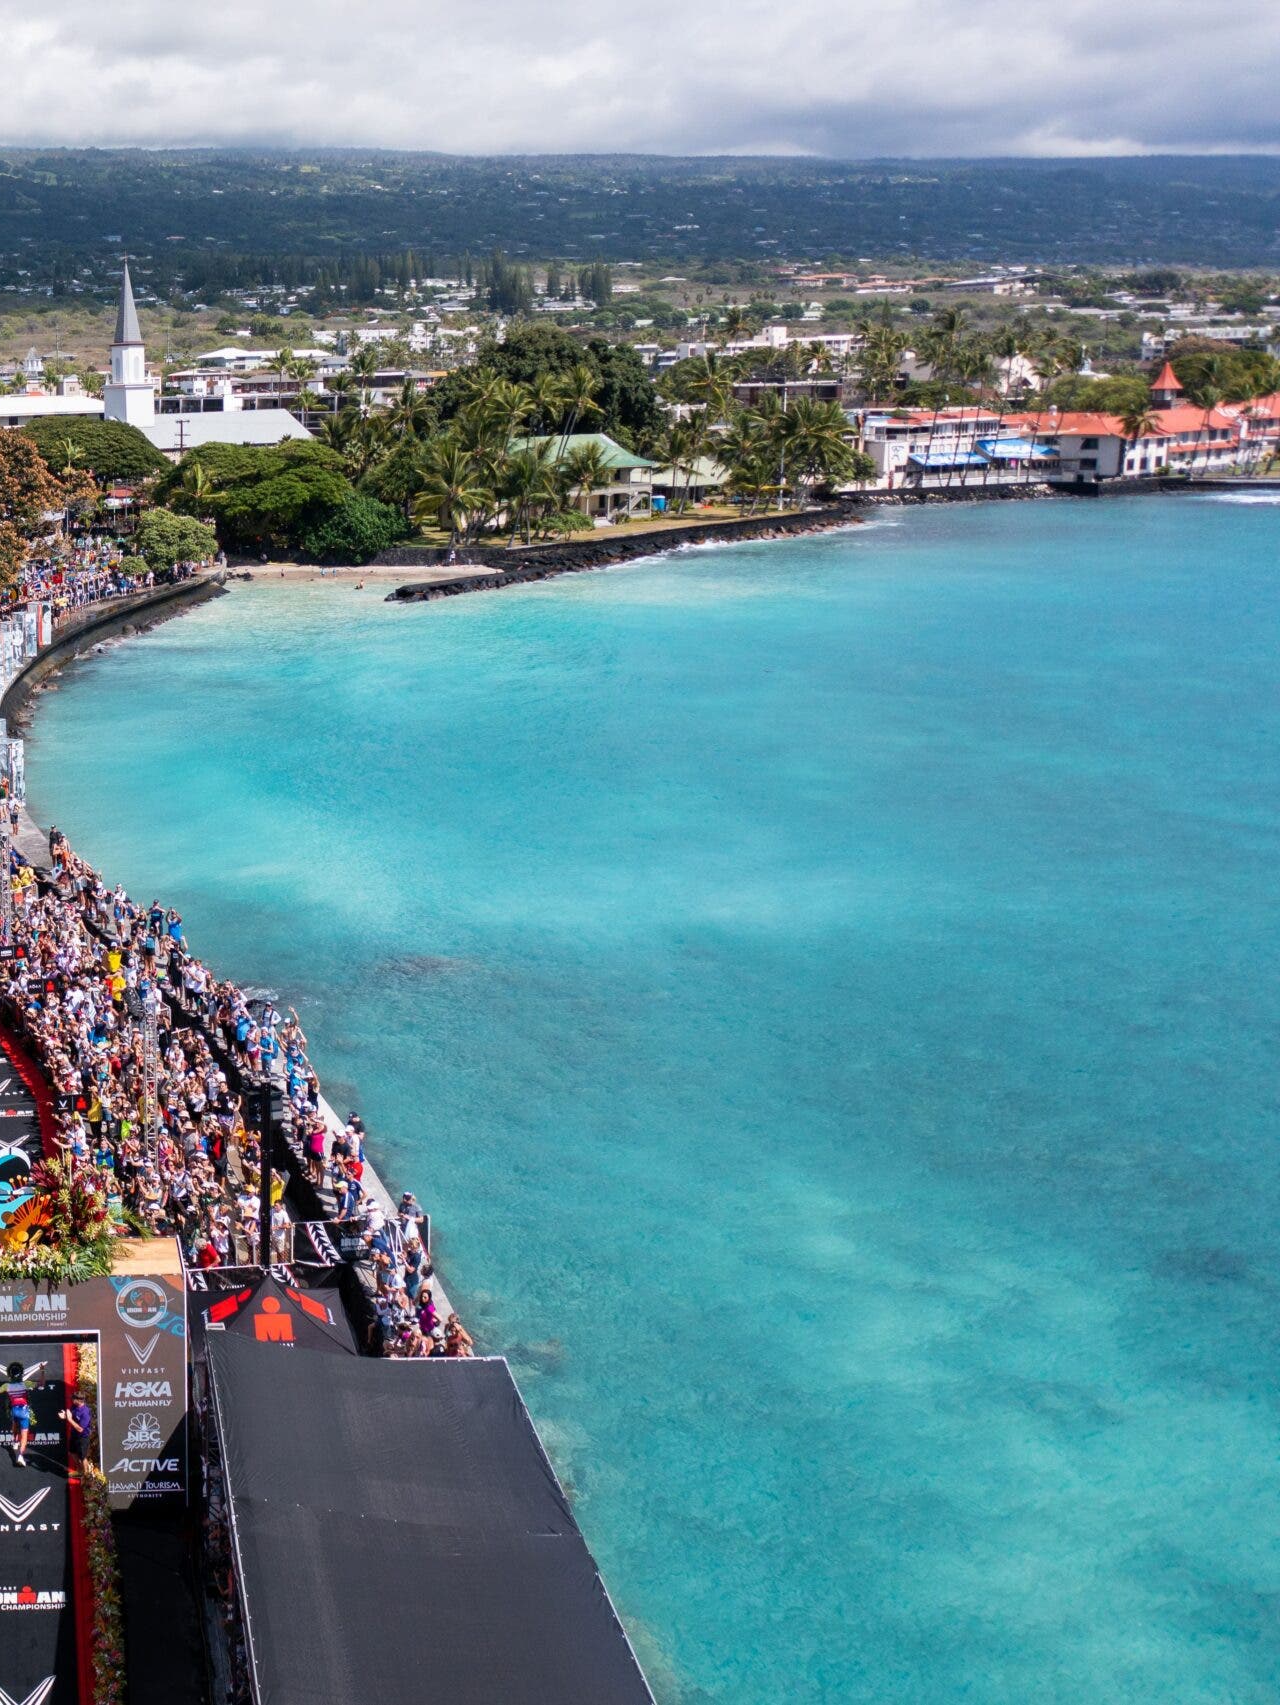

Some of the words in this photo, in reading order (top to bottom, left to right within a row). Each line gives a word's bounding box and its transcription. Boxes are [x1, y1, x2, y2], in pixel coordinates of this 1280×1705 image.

[121, 1367, 166, 1375] VINFAST
[114, 1381, 173, 1398] HOKA
[114, 1400, 128, 1408] FLY
[128, 1400, 159, 1408] HUMAN
[159, 1399, 173, 1407] FLY
[127, 1431, 161, 1442] NBC
[122, 1439, 165, 1452] Sports
[108, 1458, 180, 1473] ACTIVE
[1, 1603, 66, 1611] CHAMPIONSHIP
